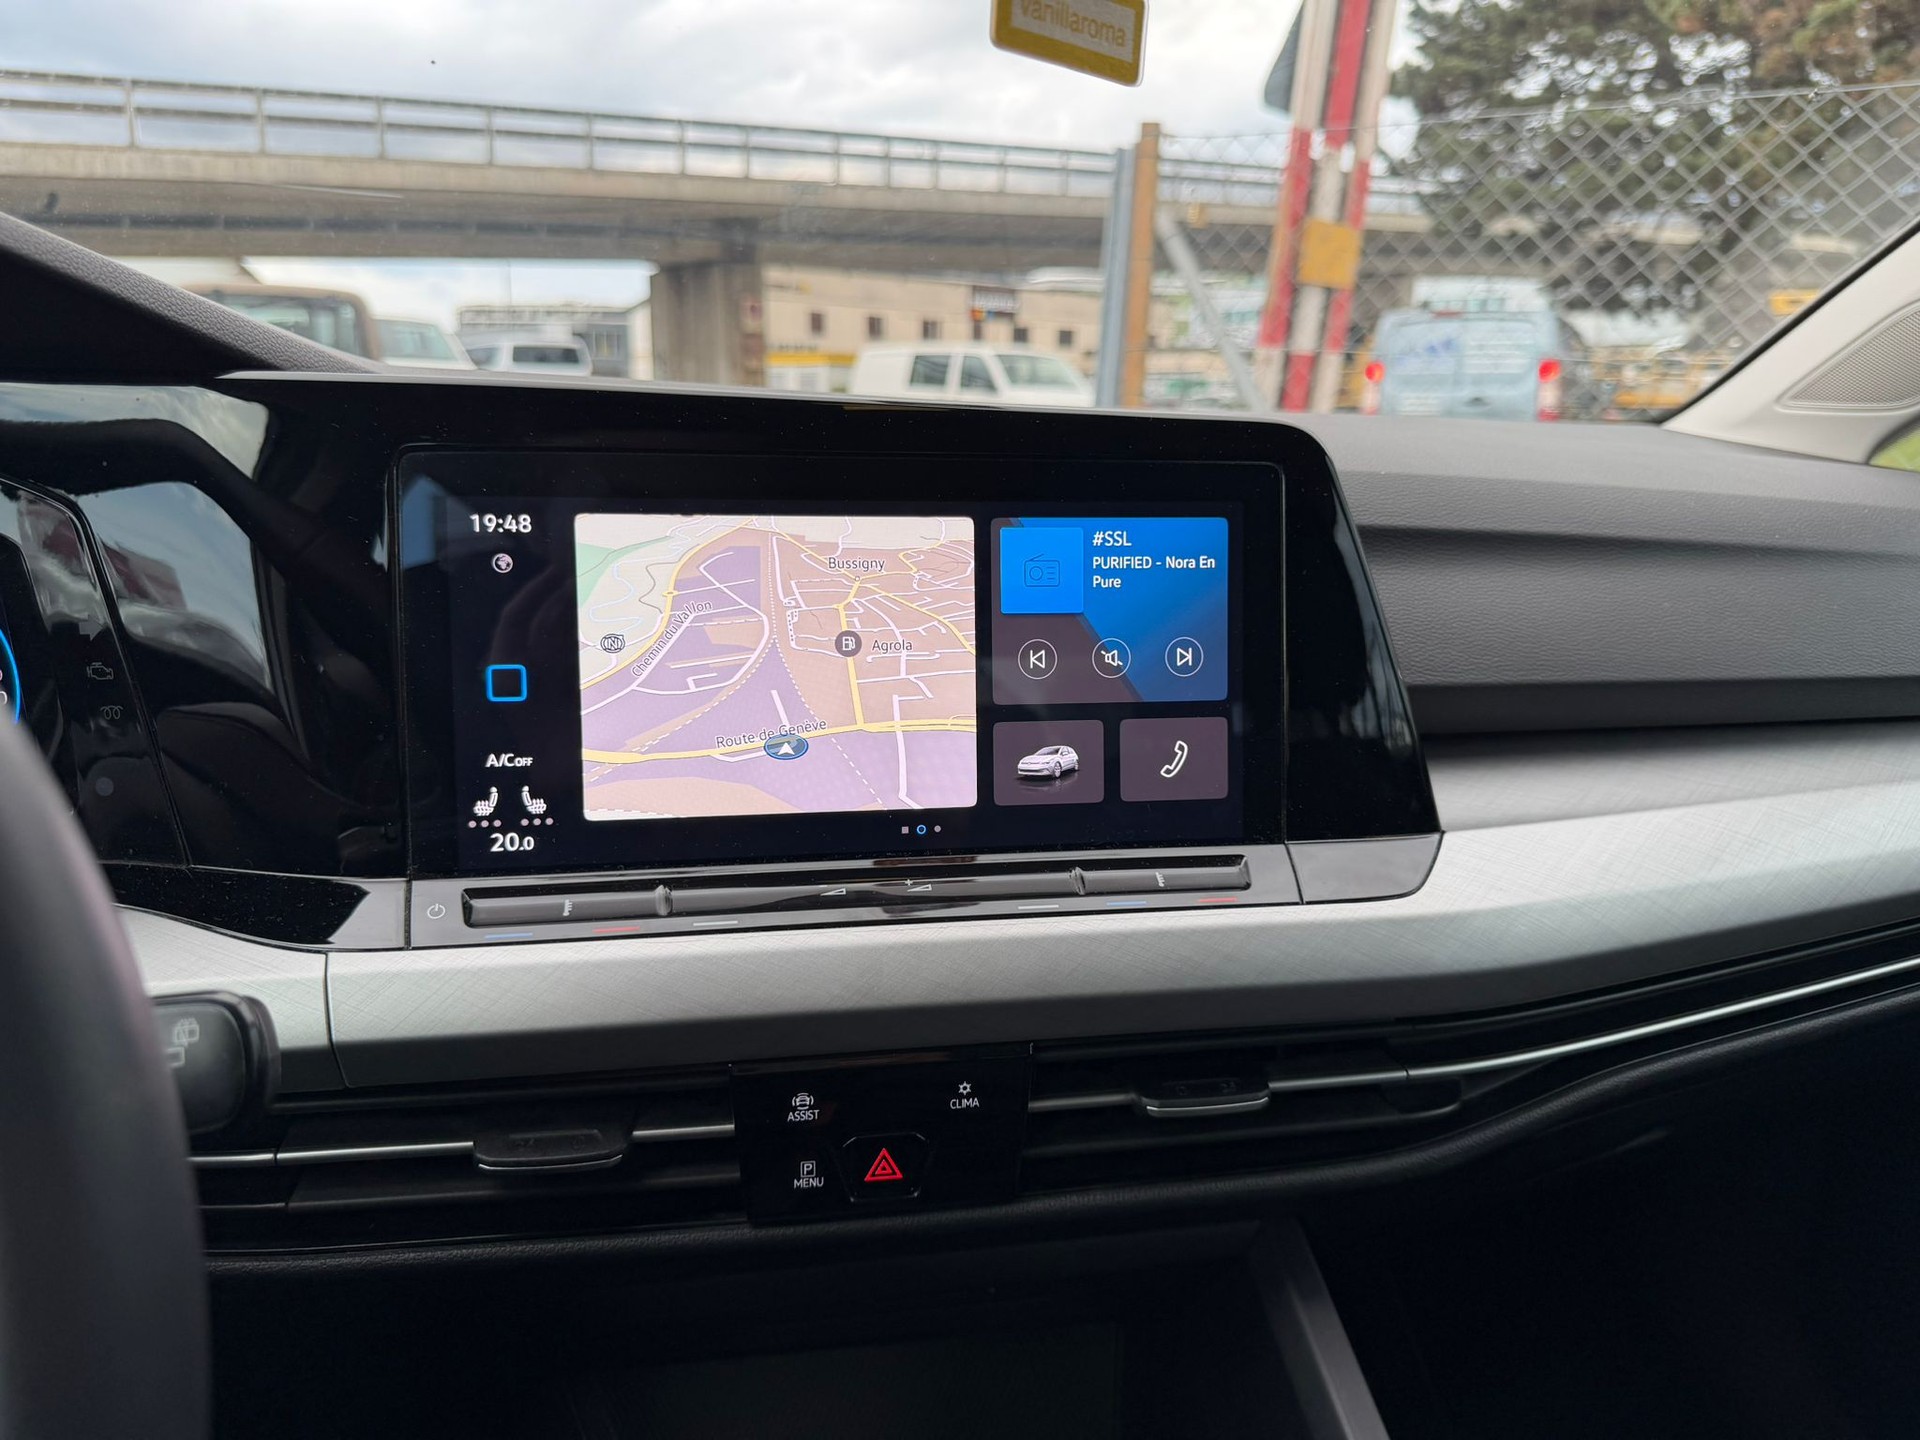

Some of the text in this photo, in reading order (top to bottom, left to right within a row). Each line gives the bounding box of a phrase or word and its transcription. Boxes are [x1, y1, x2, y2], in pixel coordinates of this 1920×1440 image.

[470, 513, 533, 533] 19:48
[1092, 530, 1132, 547] #SSL
[827, 556, 886, 572] Bussigny
[1092, 555, 1152, 569] PURIFIED
[1165, 555, 1196, 569] Nora
[1199, 555, 1216, 569] En
[1092, 575, 1122, 589] Pure
[631, 601, 713, 677] Chemin du Vallon
[871, 637, 913, 654] Agrola
[715, 719, 827, 749] Route de Genève
[489, 832, 535, 852] 20.0
[949, 1097, 980, 1110] CLIMA
[787, 1109, 820, 1122] ASSIST
[793, 1177, 824, 1189] MENU
